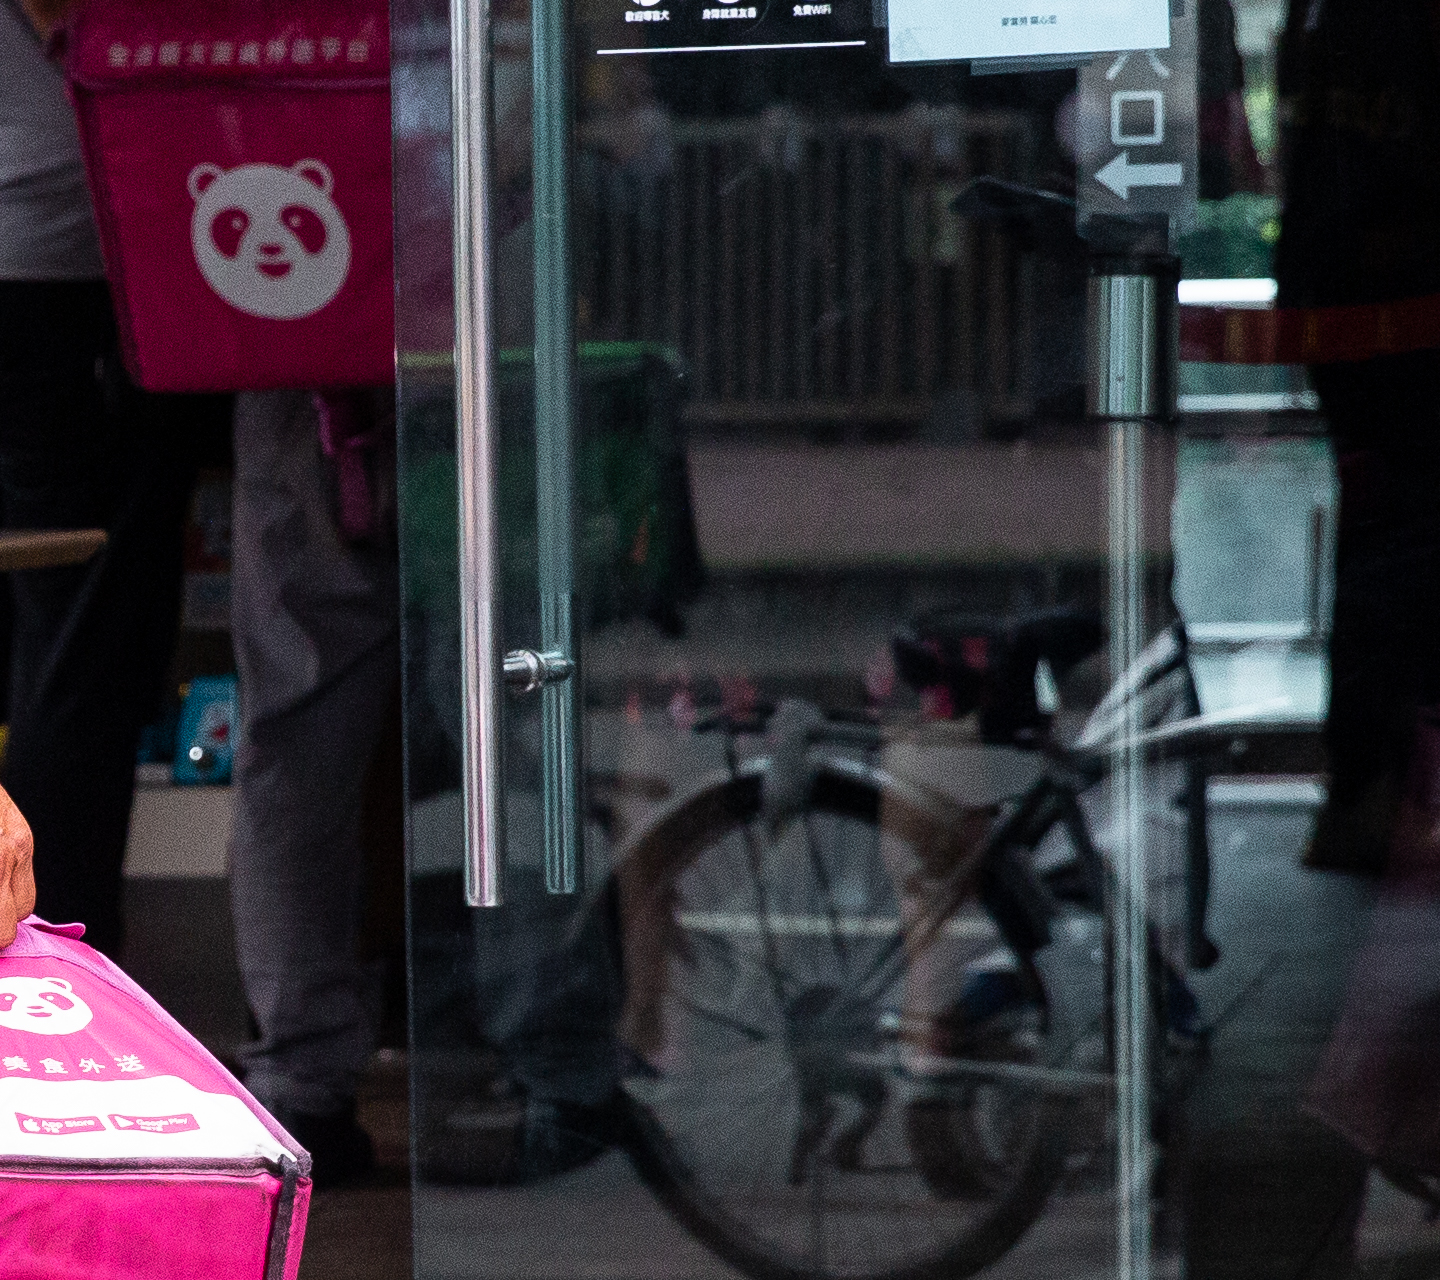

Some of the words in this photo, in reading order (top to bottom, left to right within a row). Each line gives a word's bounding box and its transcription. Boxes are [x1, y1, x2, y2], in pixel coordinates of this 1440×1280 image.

[2, 1053, 146, 1075] 美食外送
[42, 1119, 64, 1130] App
[64, 1118, 96, 1128] Store
